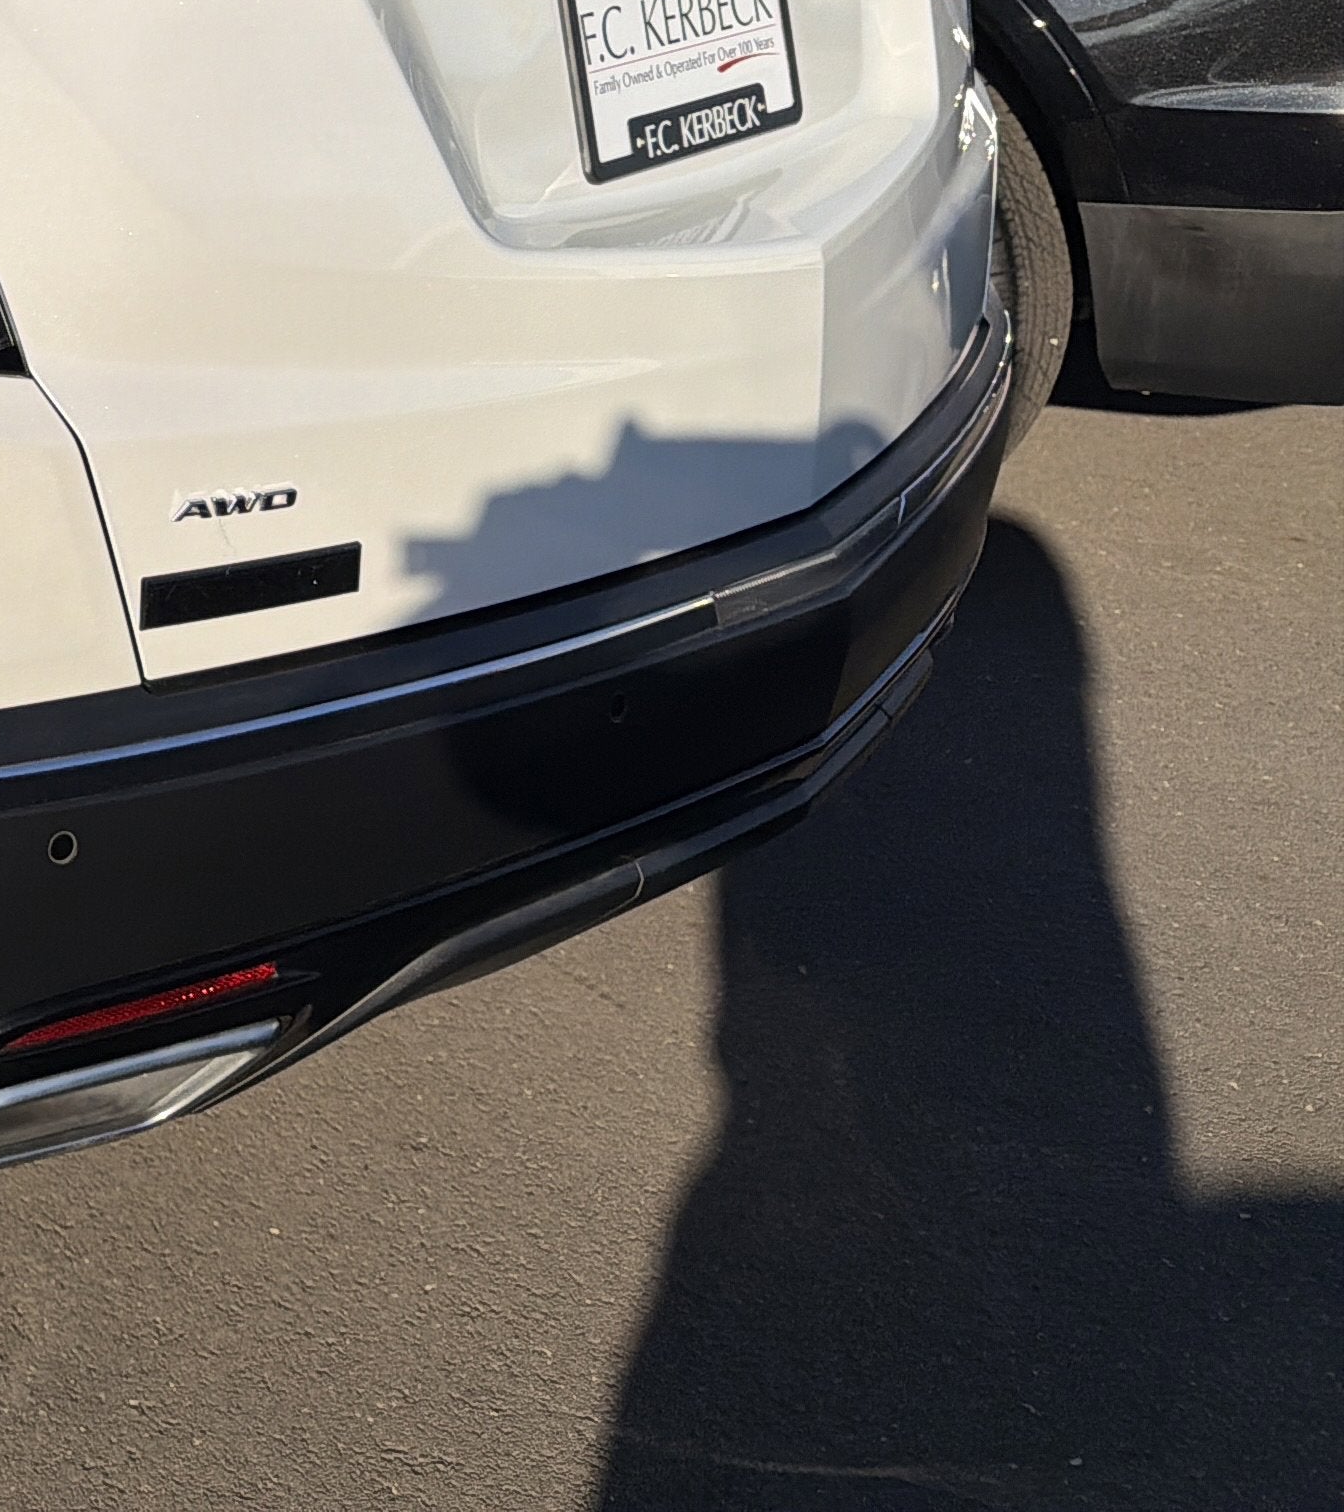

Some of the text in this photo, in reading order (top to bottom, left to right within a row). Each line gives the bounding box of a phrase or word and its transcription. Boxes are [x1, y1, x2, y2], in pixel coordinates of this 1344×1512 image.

[580, 4, 635, 66] F.C.
[593, 37, 775, 96] Family Owned & Operated For Over 100 Years
[644, 95, 761, 159] F.C. KERBECK
[170, 487, 298, 522] AWD
